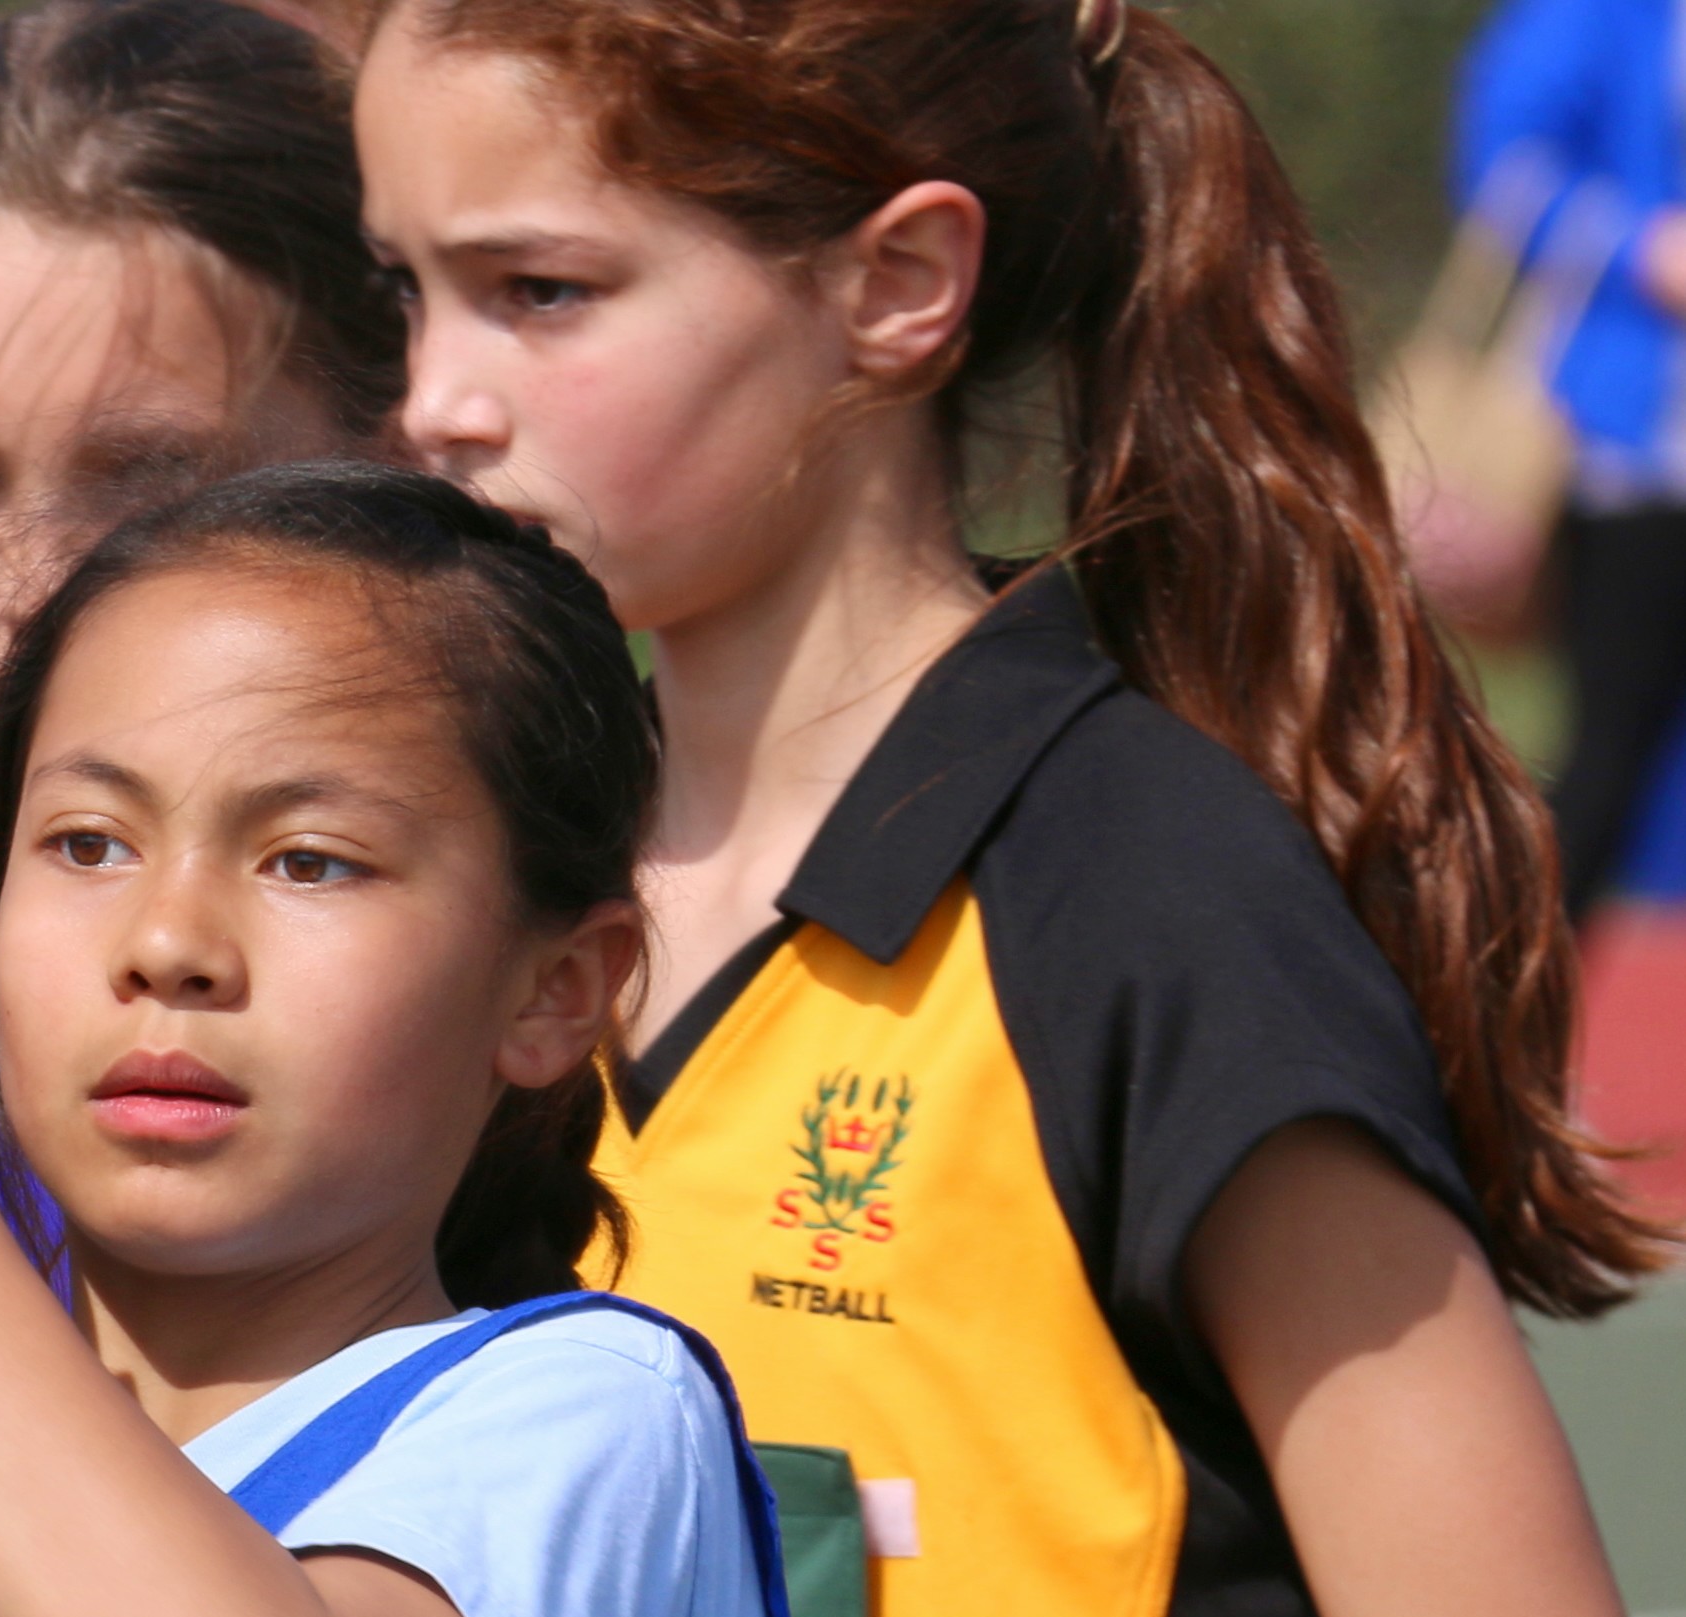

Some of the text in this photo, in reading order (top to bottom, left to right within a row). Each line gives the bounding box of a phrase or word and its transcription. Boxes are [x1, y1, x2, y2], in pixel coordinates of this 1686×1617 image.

[770, 1188, 895, 1243] S S
[808, 1231, 841, 1271] S
[749, 1272, 895, 1324] NETBALL
